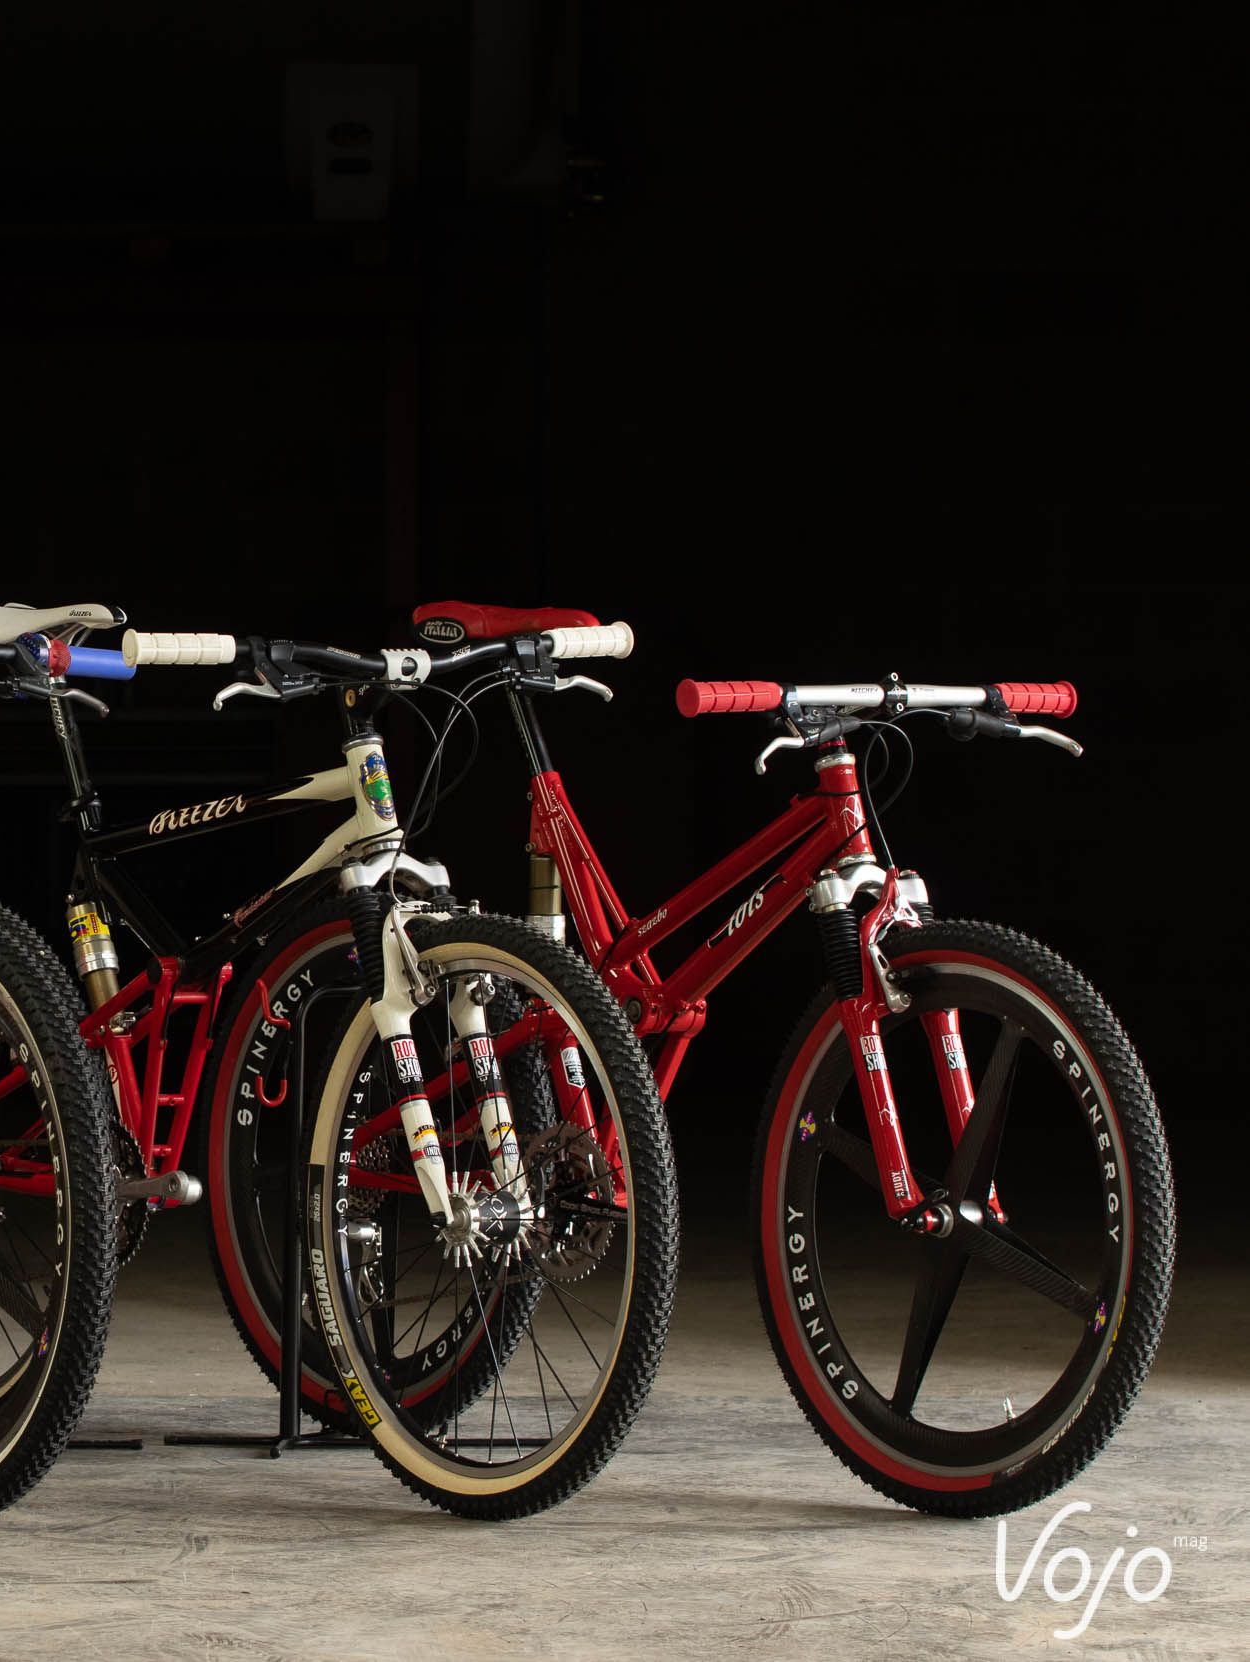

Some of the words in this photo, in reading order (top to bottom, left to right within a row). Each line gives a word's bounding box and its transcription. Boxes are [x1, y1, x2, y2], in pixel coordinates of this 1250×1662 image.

[424, 625, 459, 639] ITALIA
[50, 696, 69, 740] ITCHEY
[236, 968, 315, 1127] SPINERGY
[19, 1042, 64, 1277] SPINERGY
[335, 1071, 371, 1237] SPINERGY
[1052, 1039, 1120, 1243] SPINERGY
[310, 1248, 343, 1348] SAGUARO
[787, 1205, 859, 1400] SPINERGY
[343, 1370, 383, 1428] GEAX
